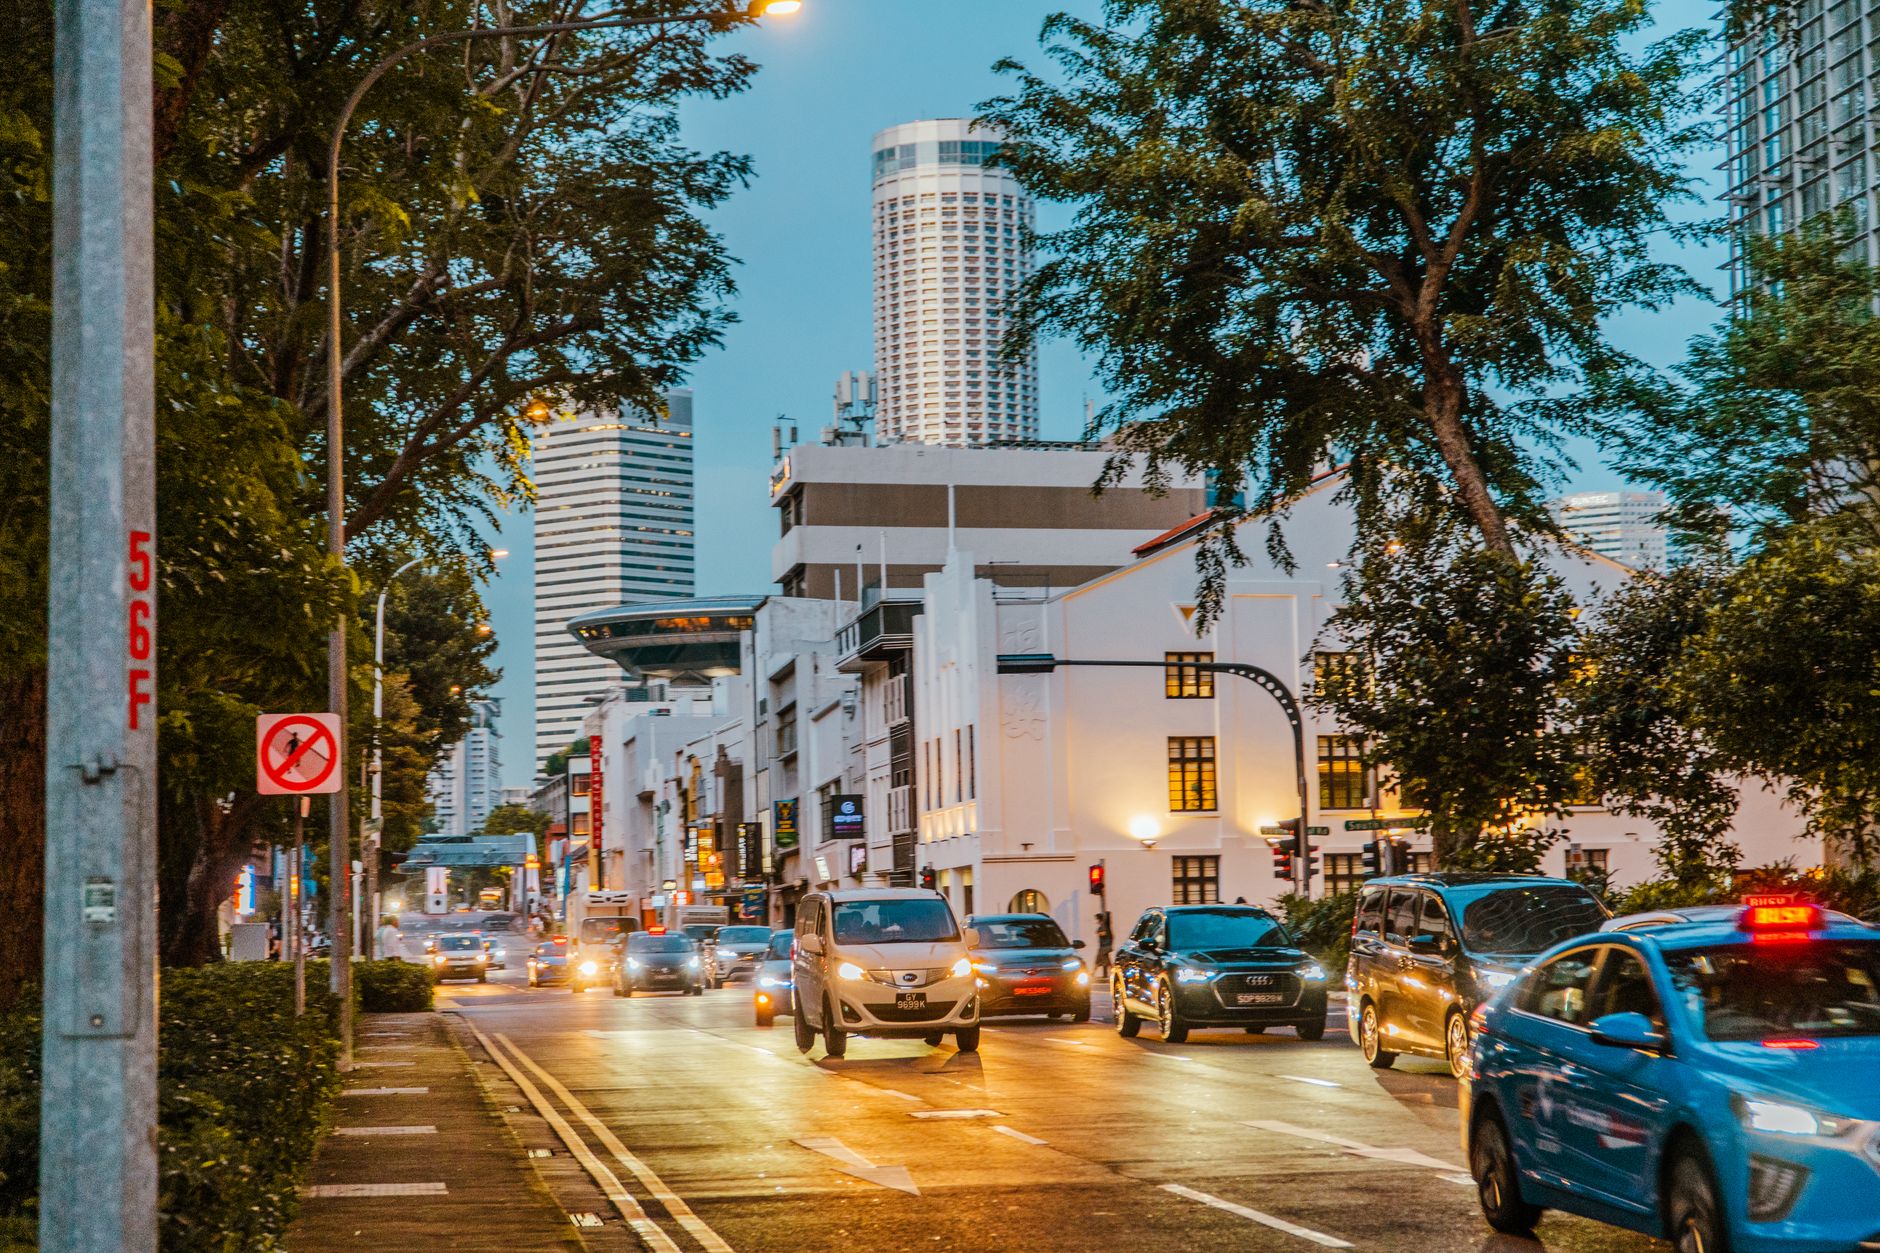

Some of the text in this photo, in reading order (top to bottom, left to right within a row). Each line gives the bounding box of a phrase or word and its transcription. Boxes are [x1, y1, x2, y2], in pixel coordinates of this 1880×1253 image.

[1571, 495, 1608, 506] SUNTEC
[905, 993, 917, 1001] GY
[897, 1000, 926, 1009] 9699K
